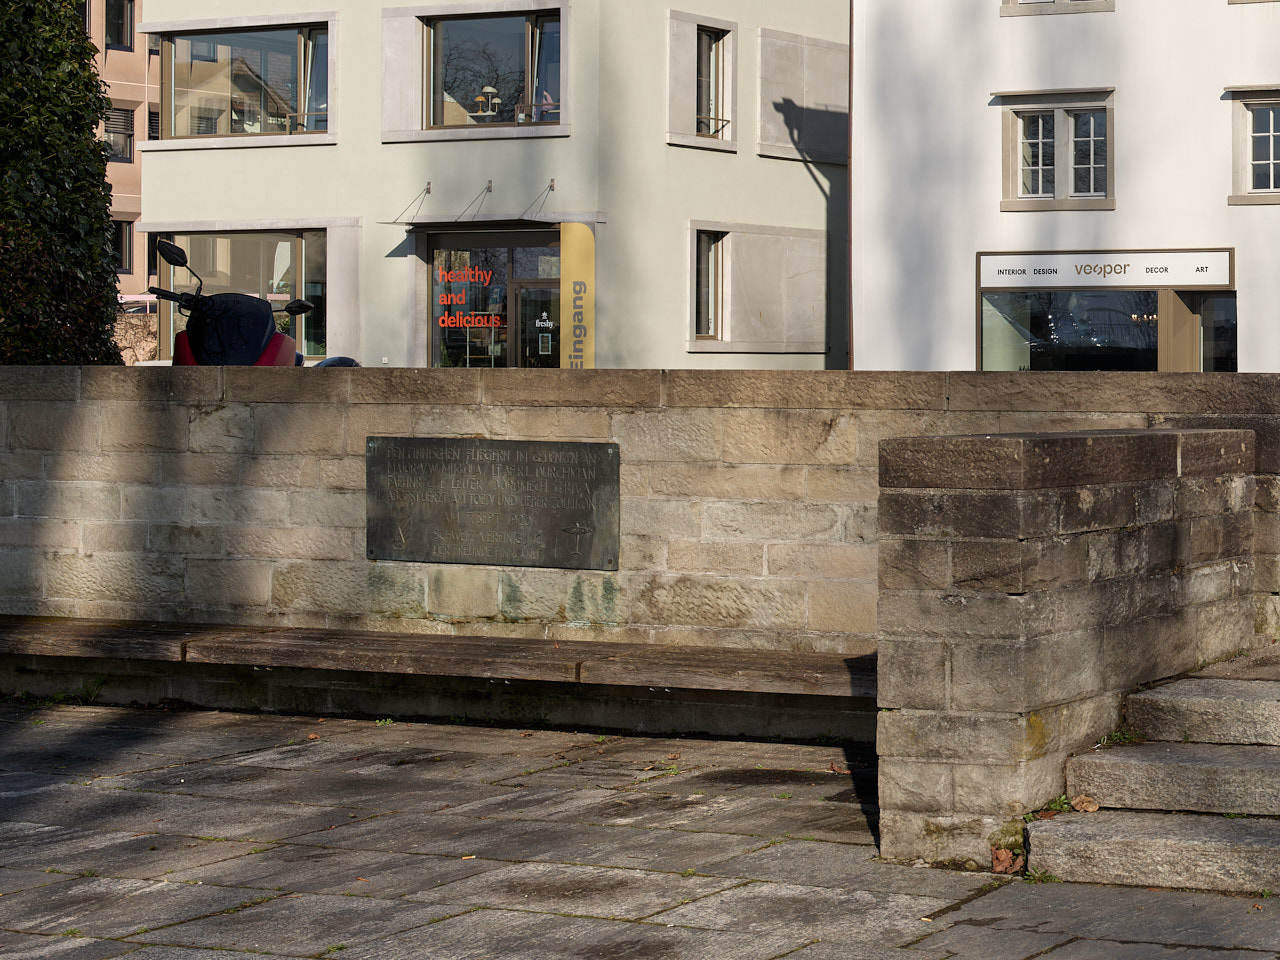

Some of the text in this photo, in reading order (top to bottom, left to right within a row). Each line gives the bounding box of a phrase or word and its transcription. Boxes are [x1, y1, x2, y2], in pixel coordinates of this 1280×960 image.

[438, 266, 493, 286] healthy
[997, 268, 1027, 276] INTERIOR
[1074, 263, 1130, 278] vesper
[1145, 266, 1169, 274] DECOR
[438, 288, 466, 305] and
[438, 311, 501, 328] delicious
[535, 319, 554, 329] freshy
